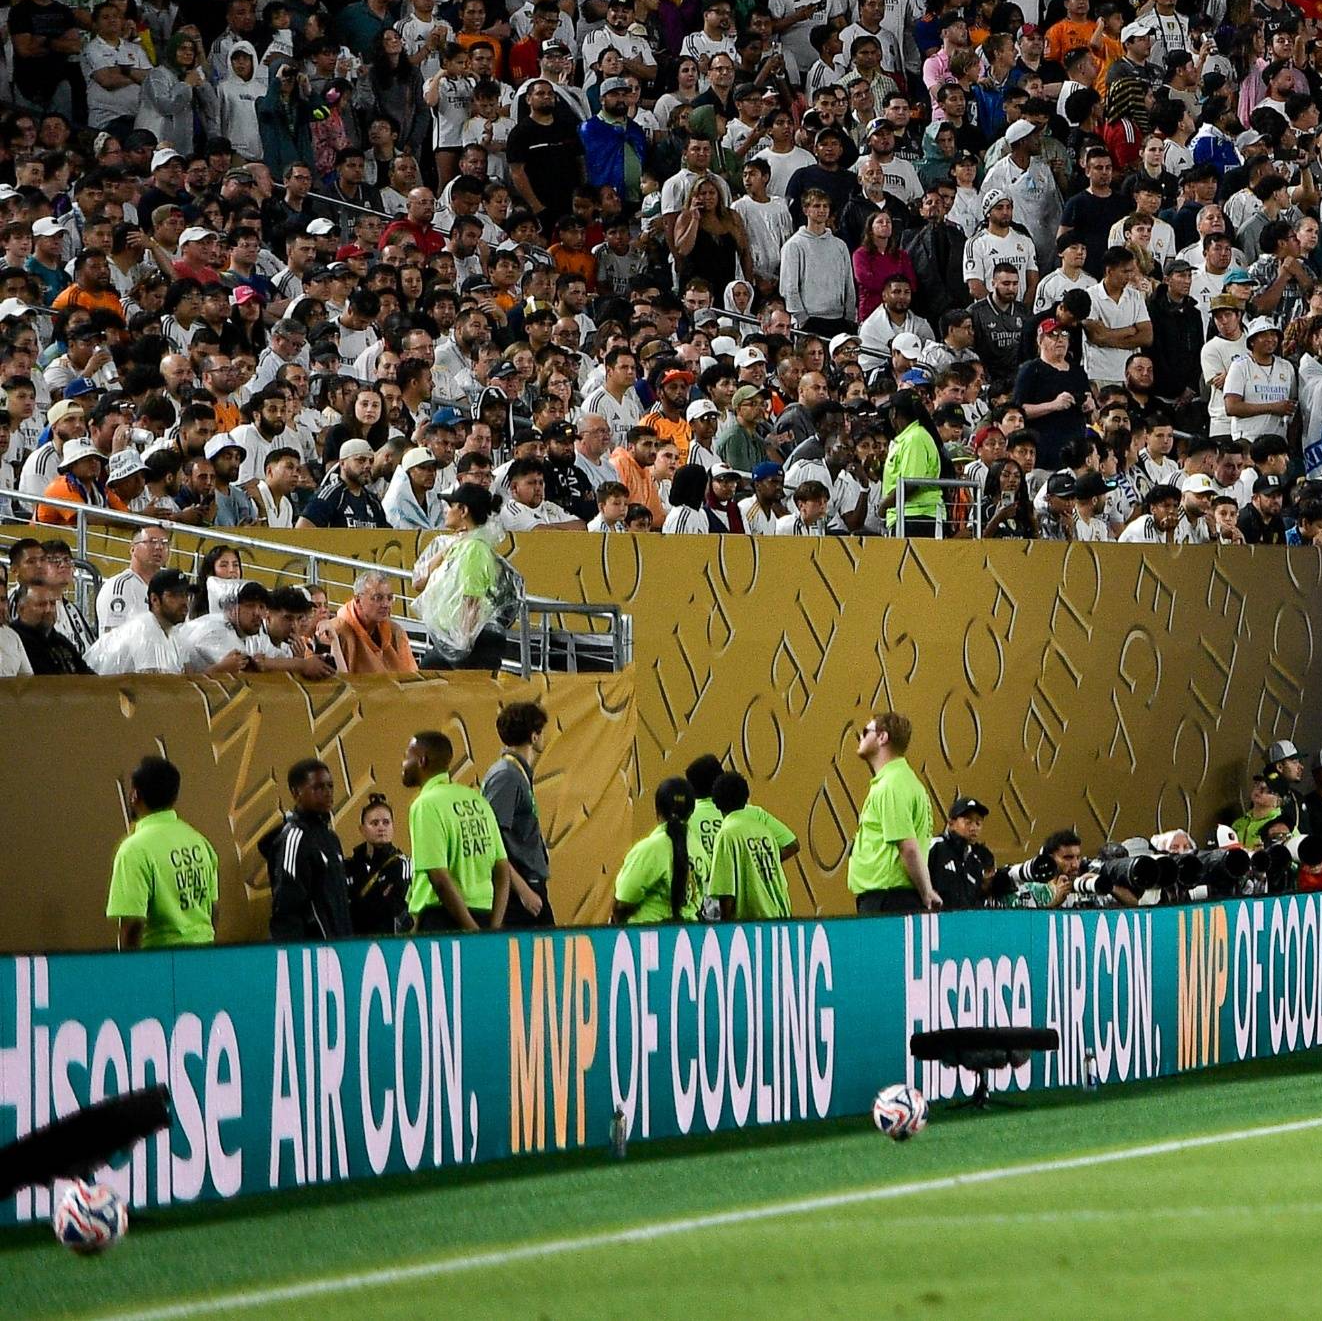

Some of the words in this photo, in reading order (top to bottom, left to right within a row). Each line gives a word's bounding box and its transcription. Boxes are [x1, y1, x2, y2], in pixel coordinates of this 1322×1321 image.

[993, 256, 1026, 264] Emirates
[453, 799, 485, 818] CSC
[170, 845, 203, 868] CSC
[904, 913, 1031, 1101] Hisense
[1044, 912, 1086, 1087] AIR
[1093, 912, 1161, 1084] CON,
[1177, 901, 1228, 1072] MVP
[1233, 899, 1264, 1060] OF
[270, 945, 350, 1188] AIR
[360, 940, 480, 1176] CON,
[508, 934, 598, 1155] MVP
[609, 929, 659, 1140] OF
[670, 922, 834, 1134] COOLING
